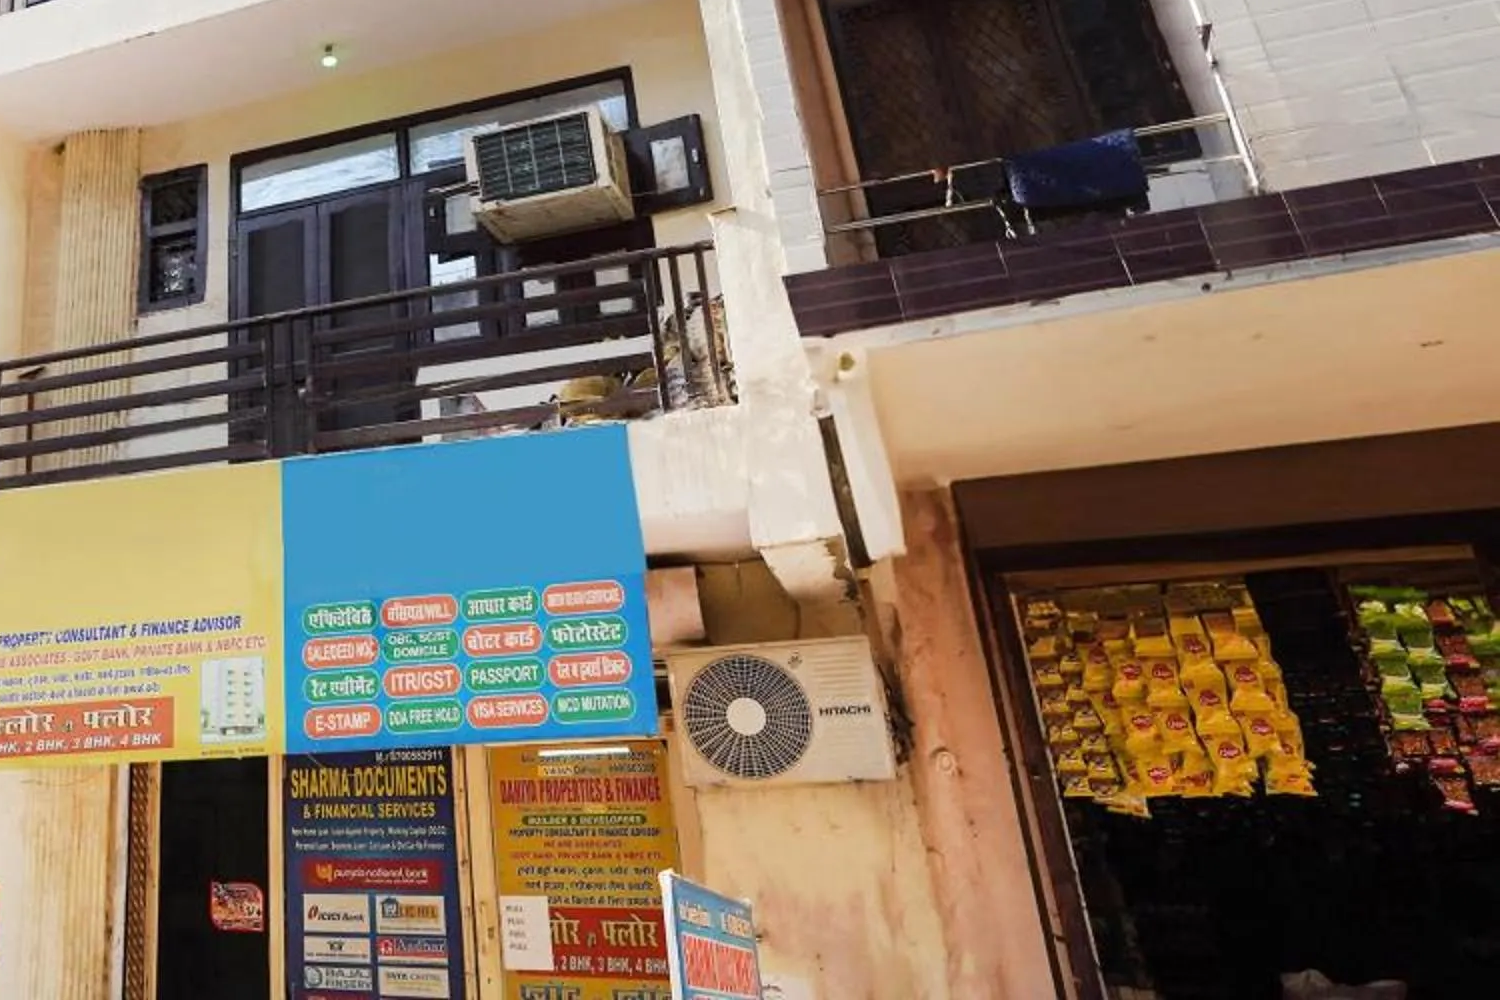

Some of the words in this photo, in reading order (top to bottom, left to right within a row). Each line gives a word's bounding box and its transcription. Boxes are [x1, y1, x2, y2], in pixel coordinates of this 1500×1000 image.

[56, 624, 127, 644] CONSULTANT
[129, 622, 138, 638] &
[141, 619, 190, 637] FINANCE
[191, 615, 242, 633] ADVISOR
[393, 644, 448, 658] DOMICILE
[391, 670, 454, 692] ITR/GST
[471, 664, 538, 685] PASSPORT
[819, 704, 871, 716] HITACHI
[315, 711, 371, 733] E-STAMP
[25, 741, 33, 752] 2
[132, 732, 162, 746] BHK
[291, 767, 350, 798] SHARMA
[353, 764, 447, 797] DOCUMENTS
[303, 803, 311, 819] &
[315, 802, 375, 819] FINANCIAL
[377, 801, 436, 818] SERVICES
[561, 955, 567, 970] 2
[598, 956, 605, 973] 3
[635, 957, 642, 973] 4
